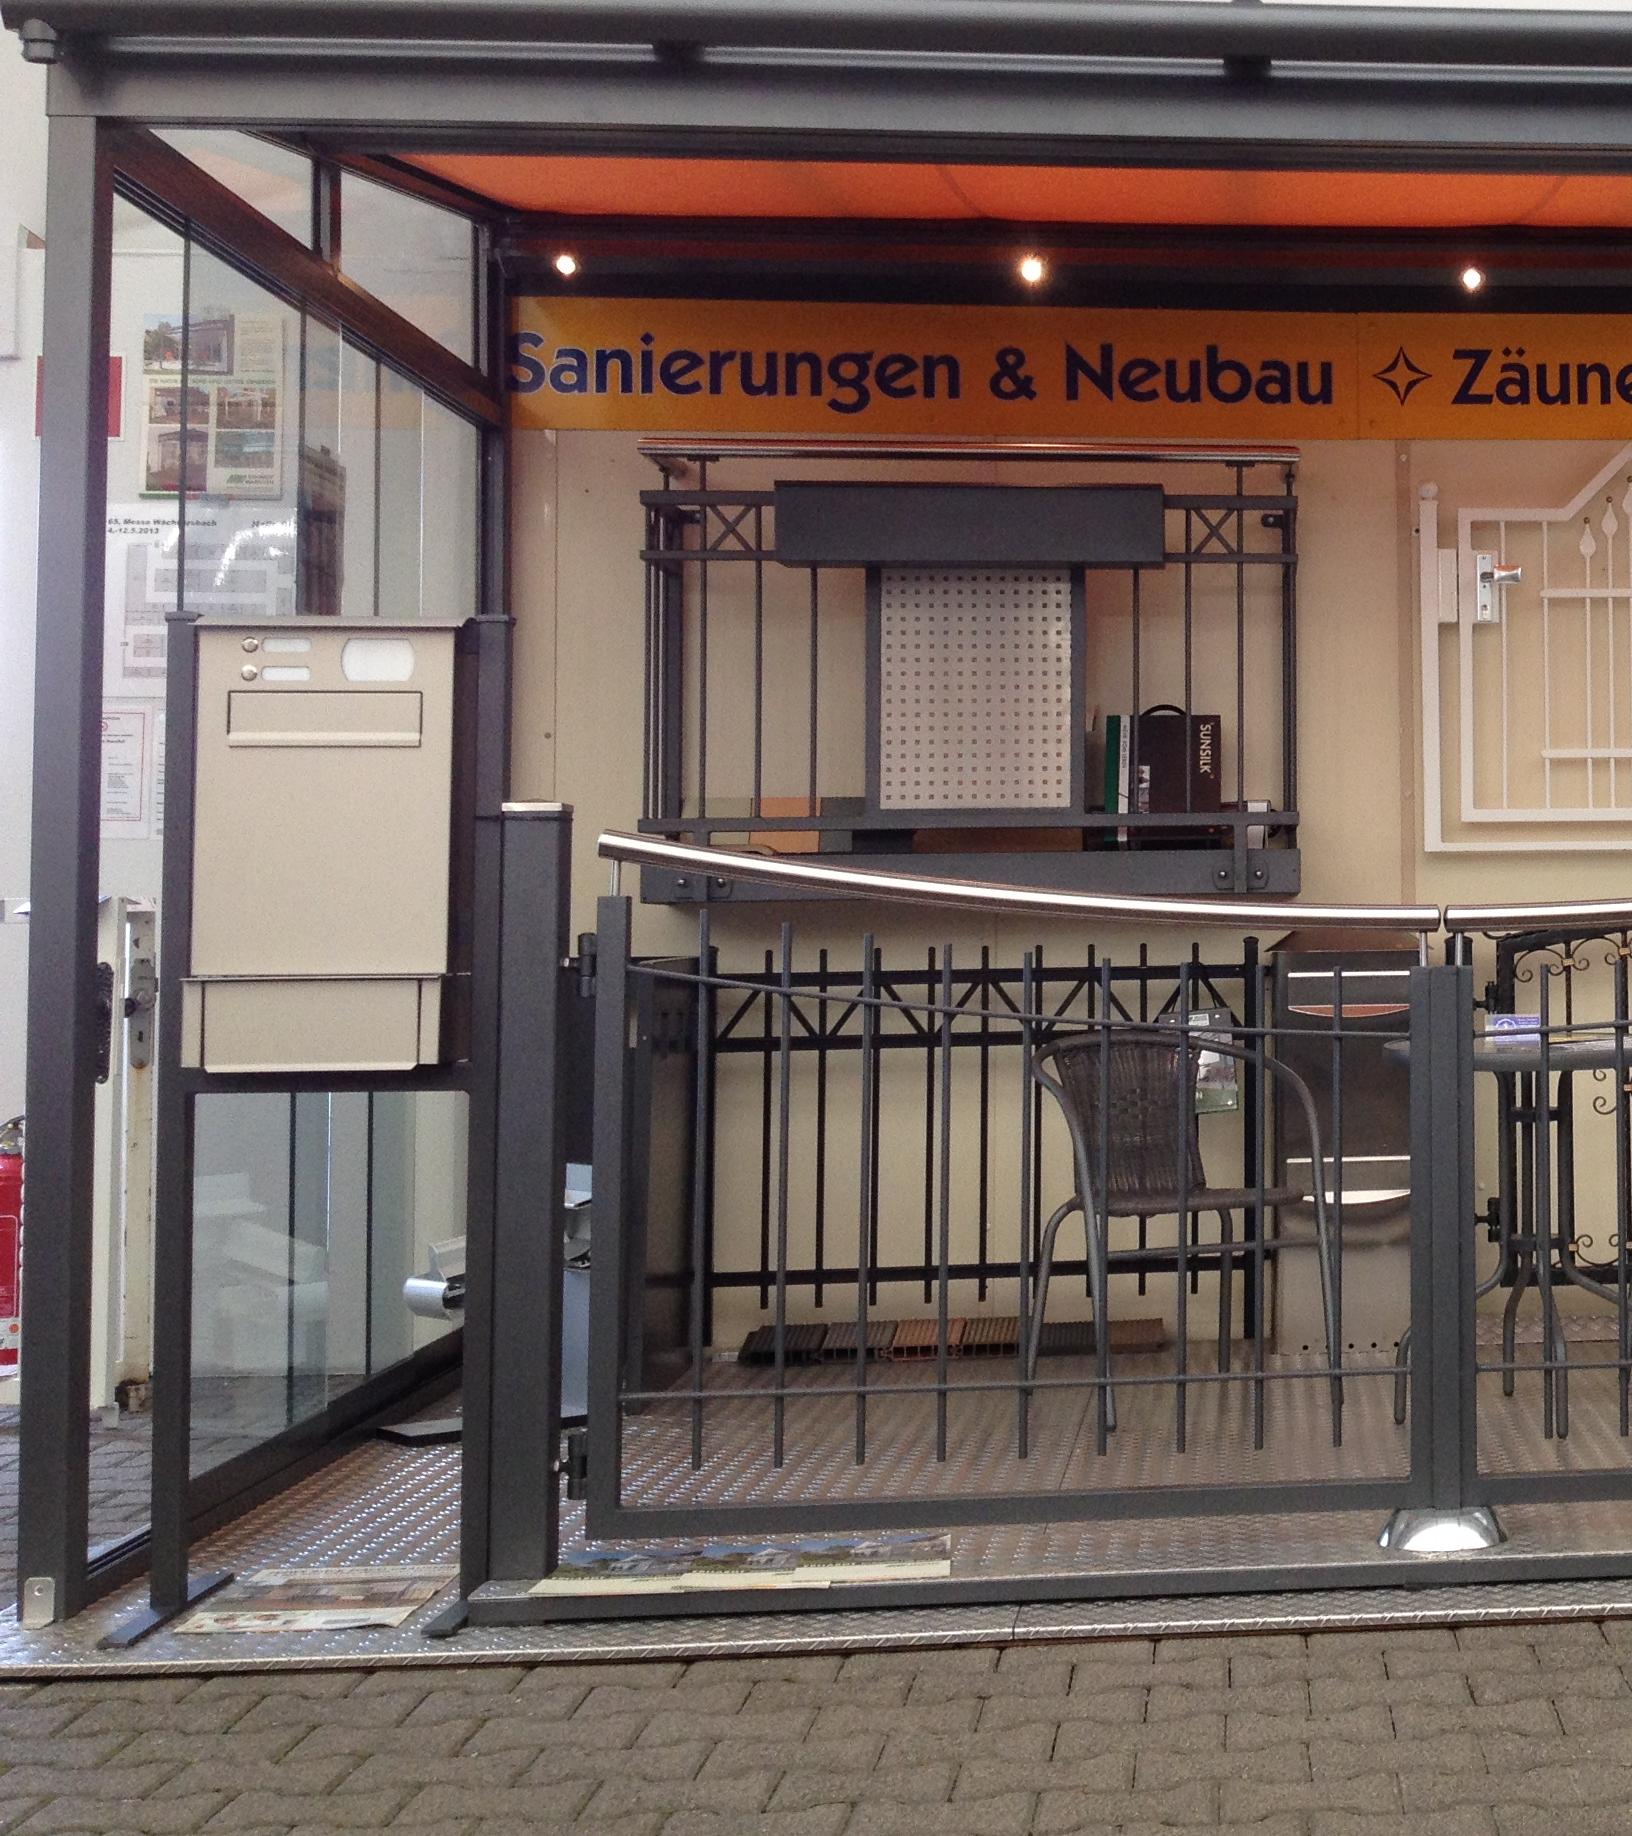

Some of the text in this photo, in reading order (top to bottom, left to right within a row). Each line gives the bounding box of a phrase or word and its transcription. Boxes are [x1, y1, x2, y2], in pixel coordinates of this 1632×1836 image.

[508, 331, 961, 414] Sanierungen
[989, 346, 1036, 401] &
[1065, 343, 1334, 405] Neubau
[1199, 723, 1212, 774] SUNSILK
